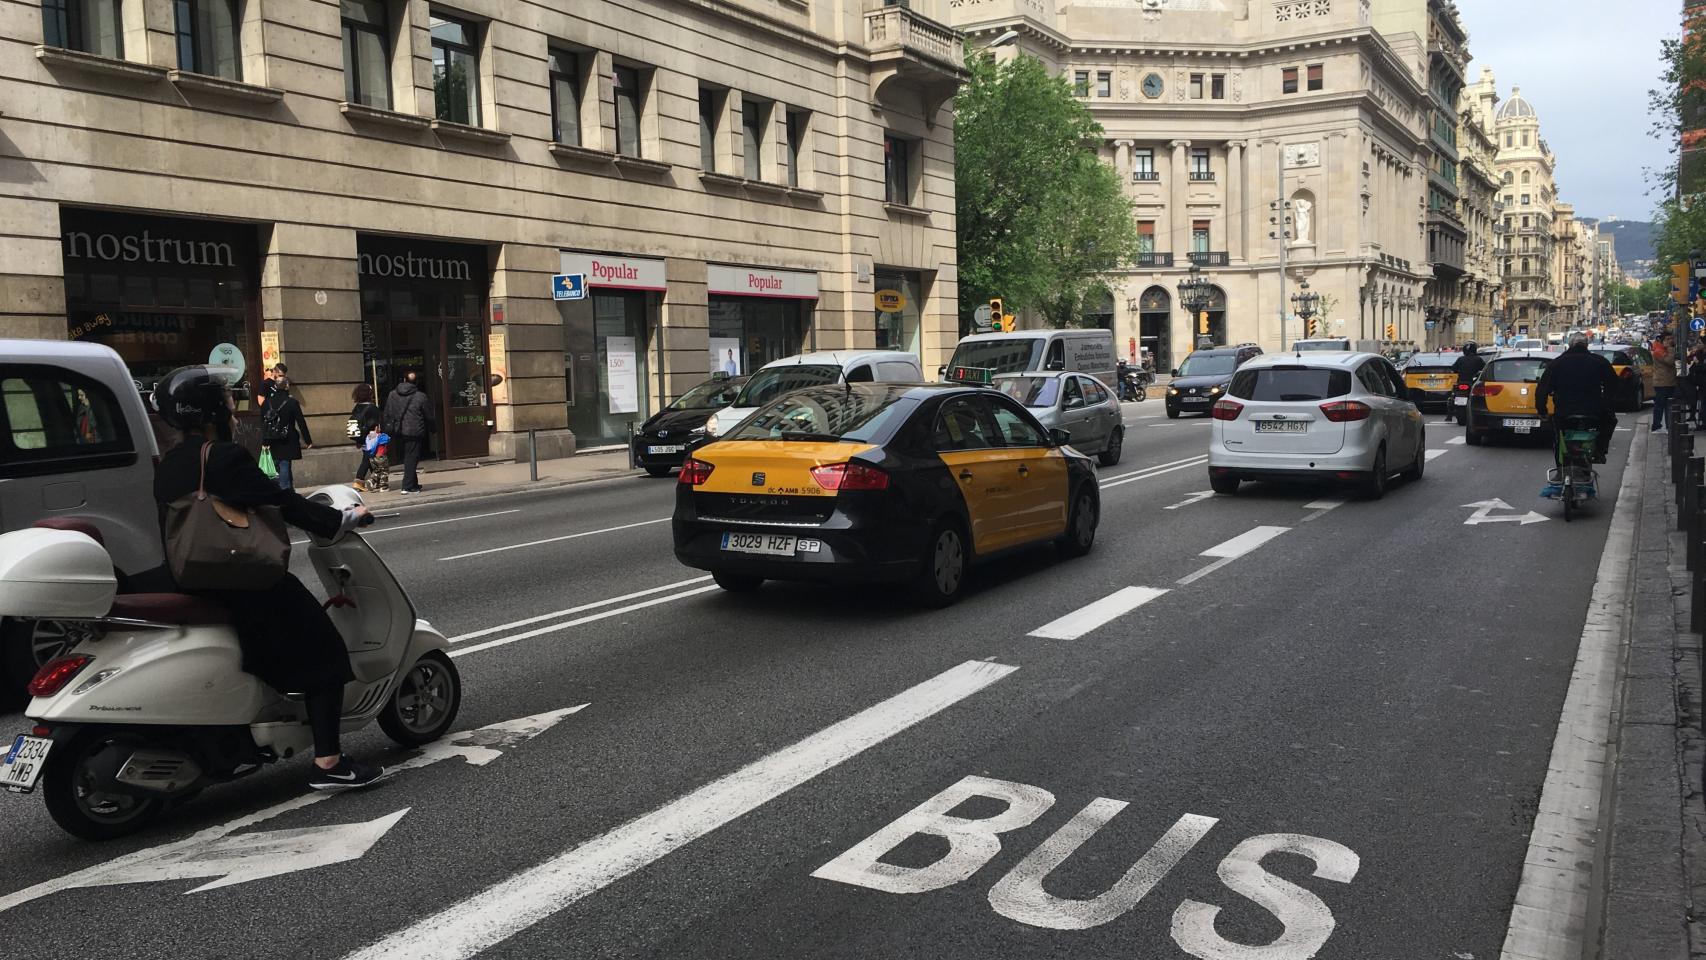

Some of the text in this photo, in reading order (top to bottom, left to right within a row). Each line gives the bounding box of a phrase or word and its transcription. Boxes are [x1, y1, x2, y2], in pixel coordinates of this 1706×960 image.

[66, 230, 236, 267] nostrum
[357, 250, 472, 281] nostrum
[591, 260, 639, 282] Popular
[748, 273, 783, 291] Popular
[556, 290, 581, 298] TELEBANCO
[1261, 421, 1284, 430] 6542
[731, 534, 818, 551] 3029 HZF SP
[16, 739, 49, 760] 2334
[7, 761, 34, 783] HWB
[809, 774, 1361, 960] BUS
